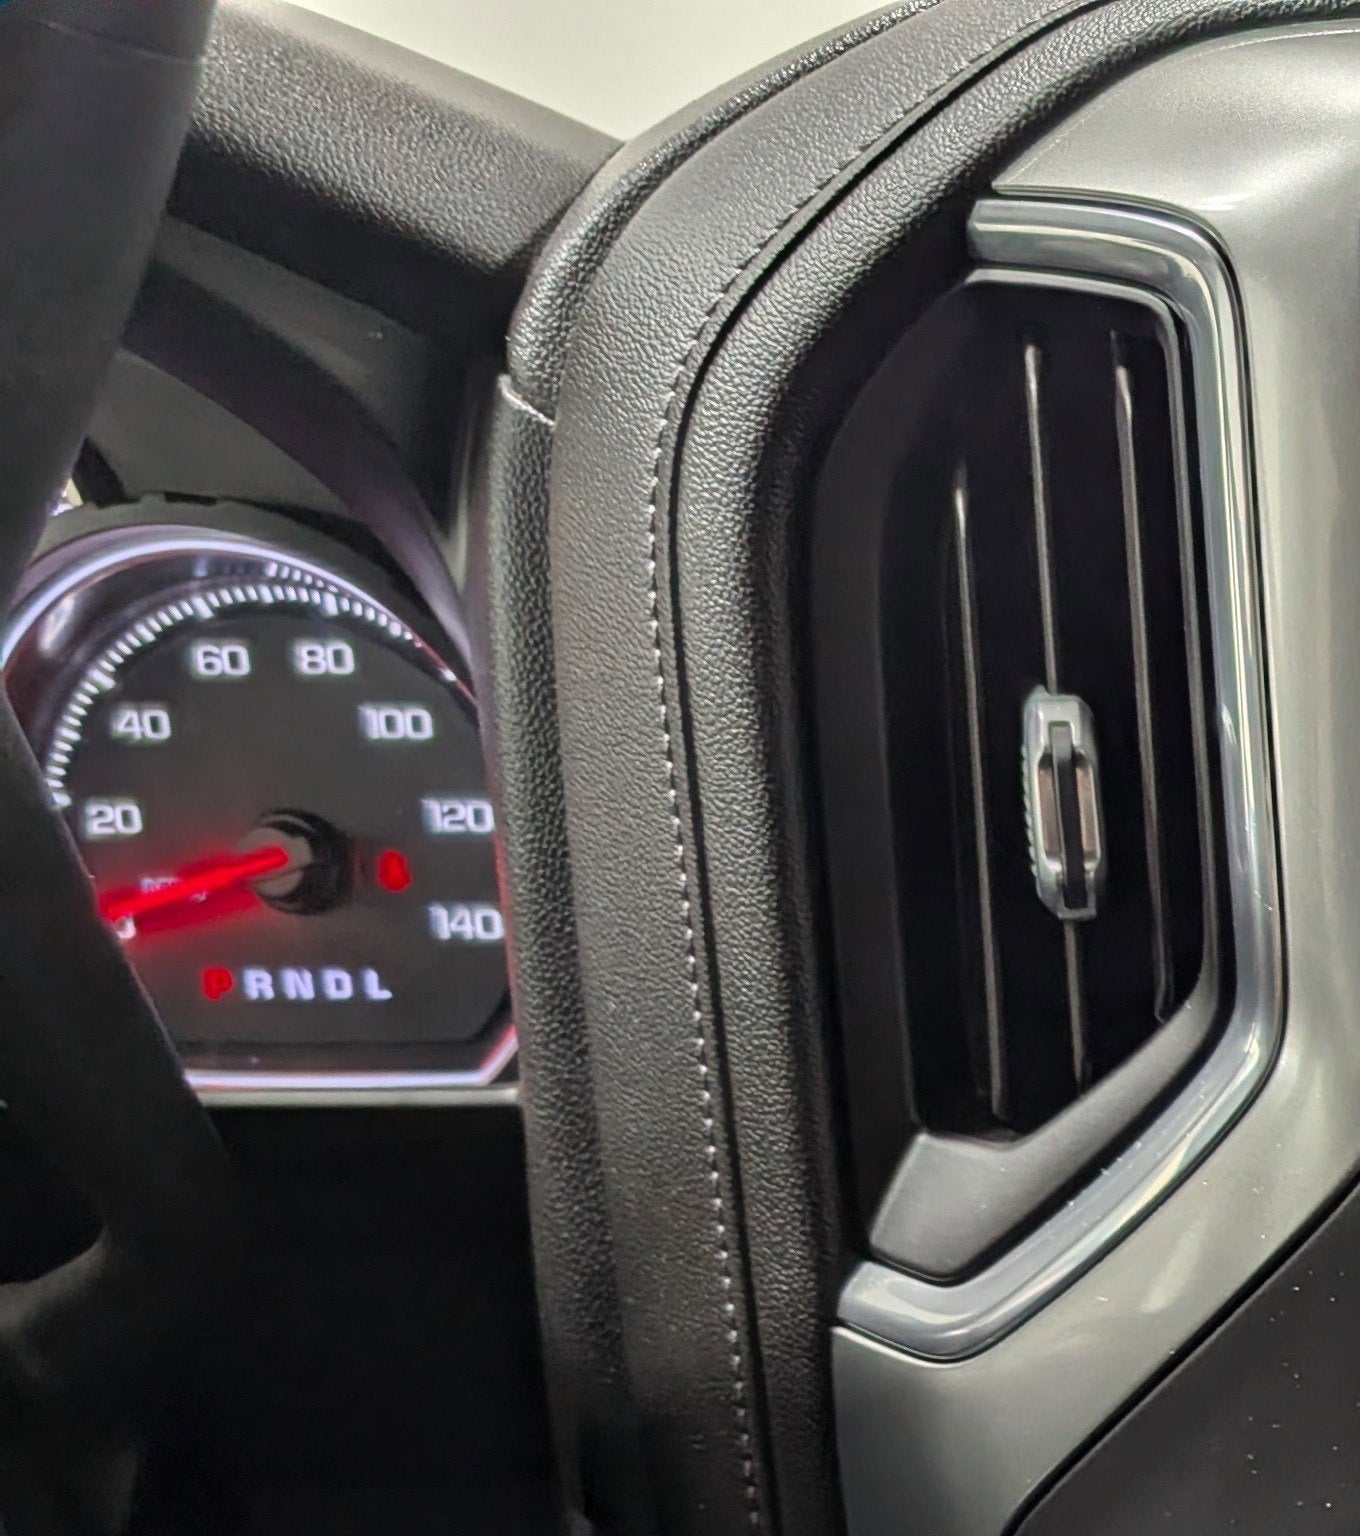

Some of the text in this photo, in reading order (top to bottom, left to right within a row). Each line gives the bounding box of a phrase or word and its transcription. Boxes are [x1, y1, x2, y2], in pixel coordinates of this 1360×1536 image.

[192, 643, 251, 676] 60
[294, 640, 355, 675] 80
[112, 708, 171, 740] 40
[360, 705, 434, 740] 100
[85, 802, 143, 836] 20
[422, 799, 496, 833] 120
[430, 906, 504, 940] 140
[204, 967, 393, 1000] P R N D L
